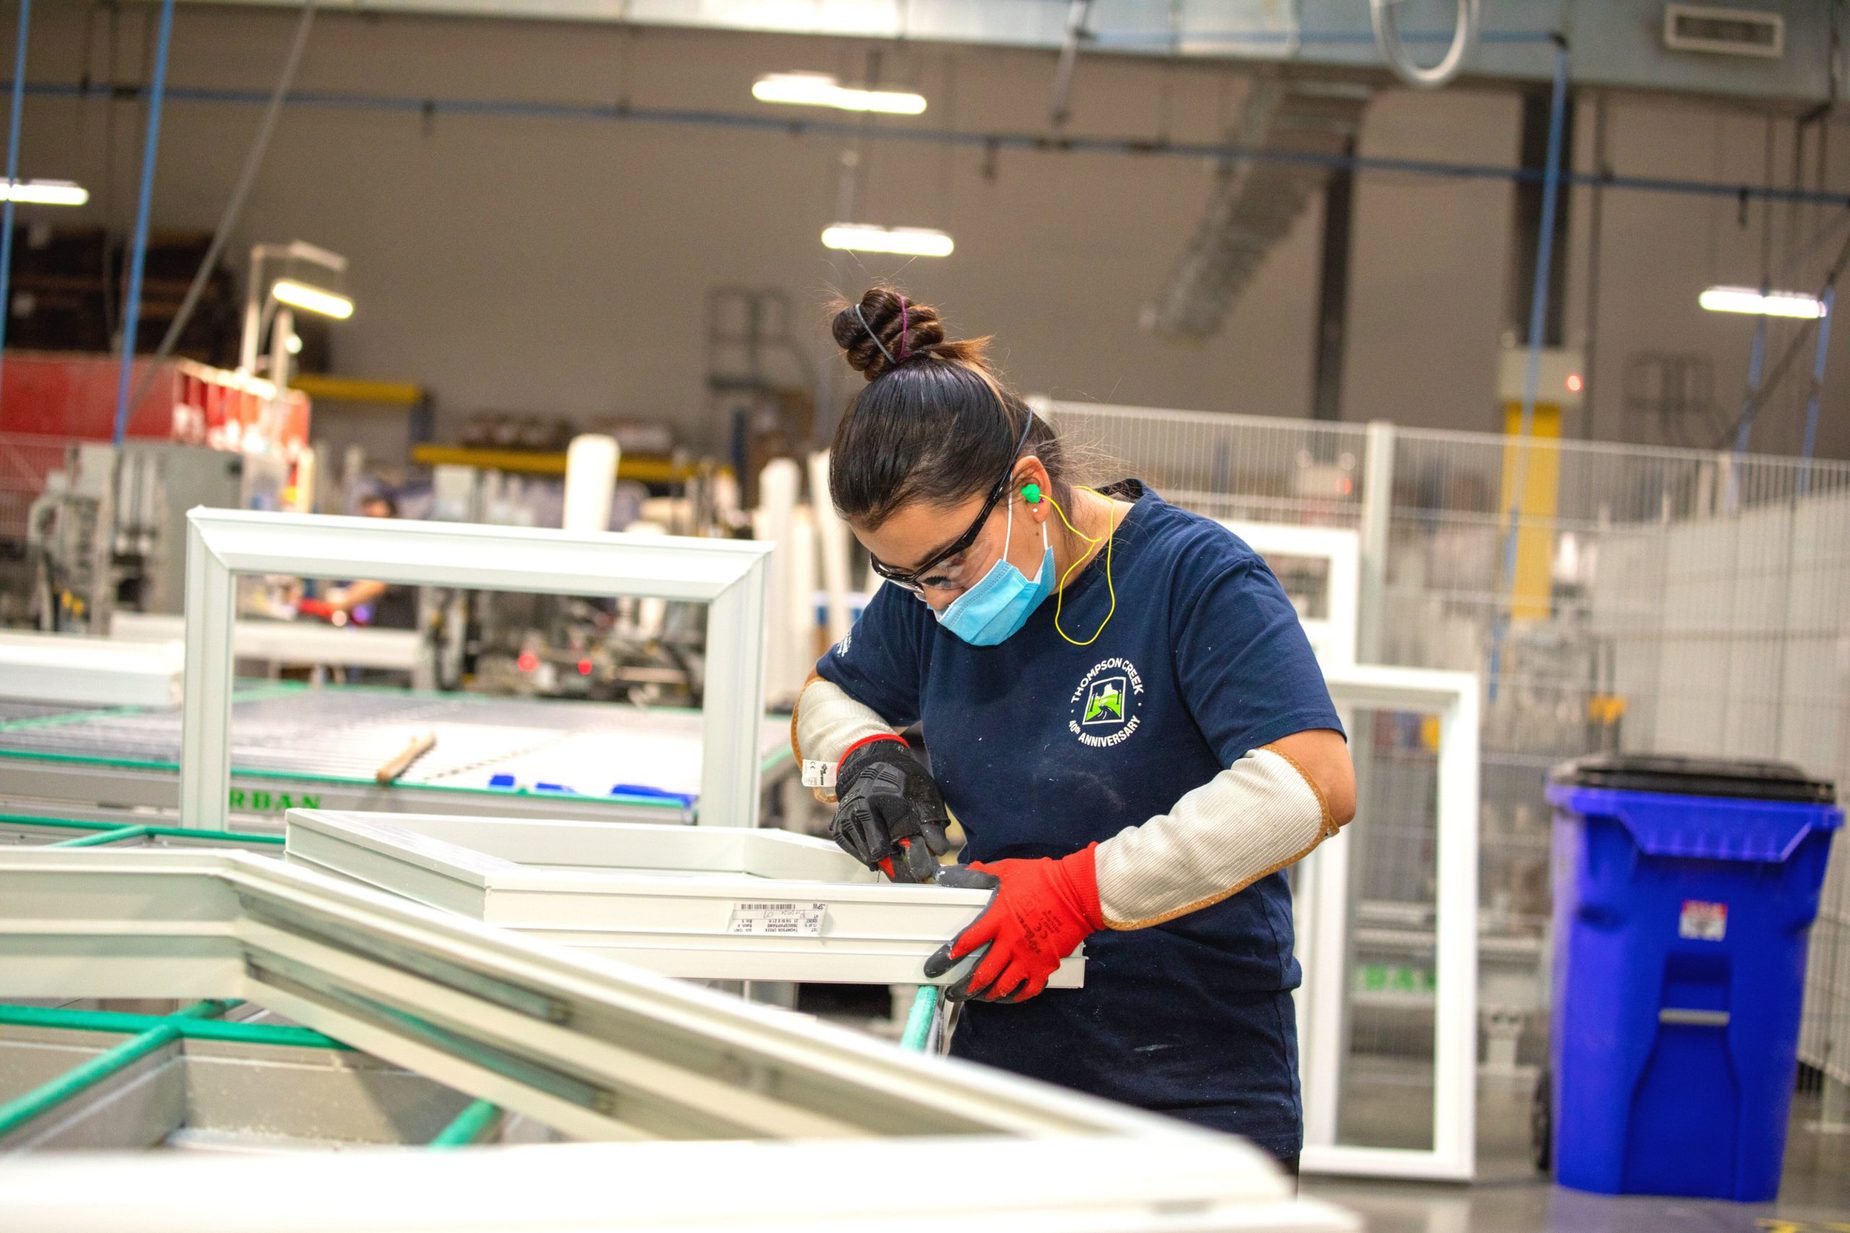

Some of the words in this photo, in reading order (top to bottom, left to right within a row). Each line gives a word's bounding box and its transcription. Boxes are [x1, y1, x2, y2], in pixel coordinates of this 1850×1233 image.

[1070, 657, 1123, 704] THOMPSON
[1121, 660, 1144, 696] CREEK
[1078, 715, 1141, 748] ANNIVERSARY
